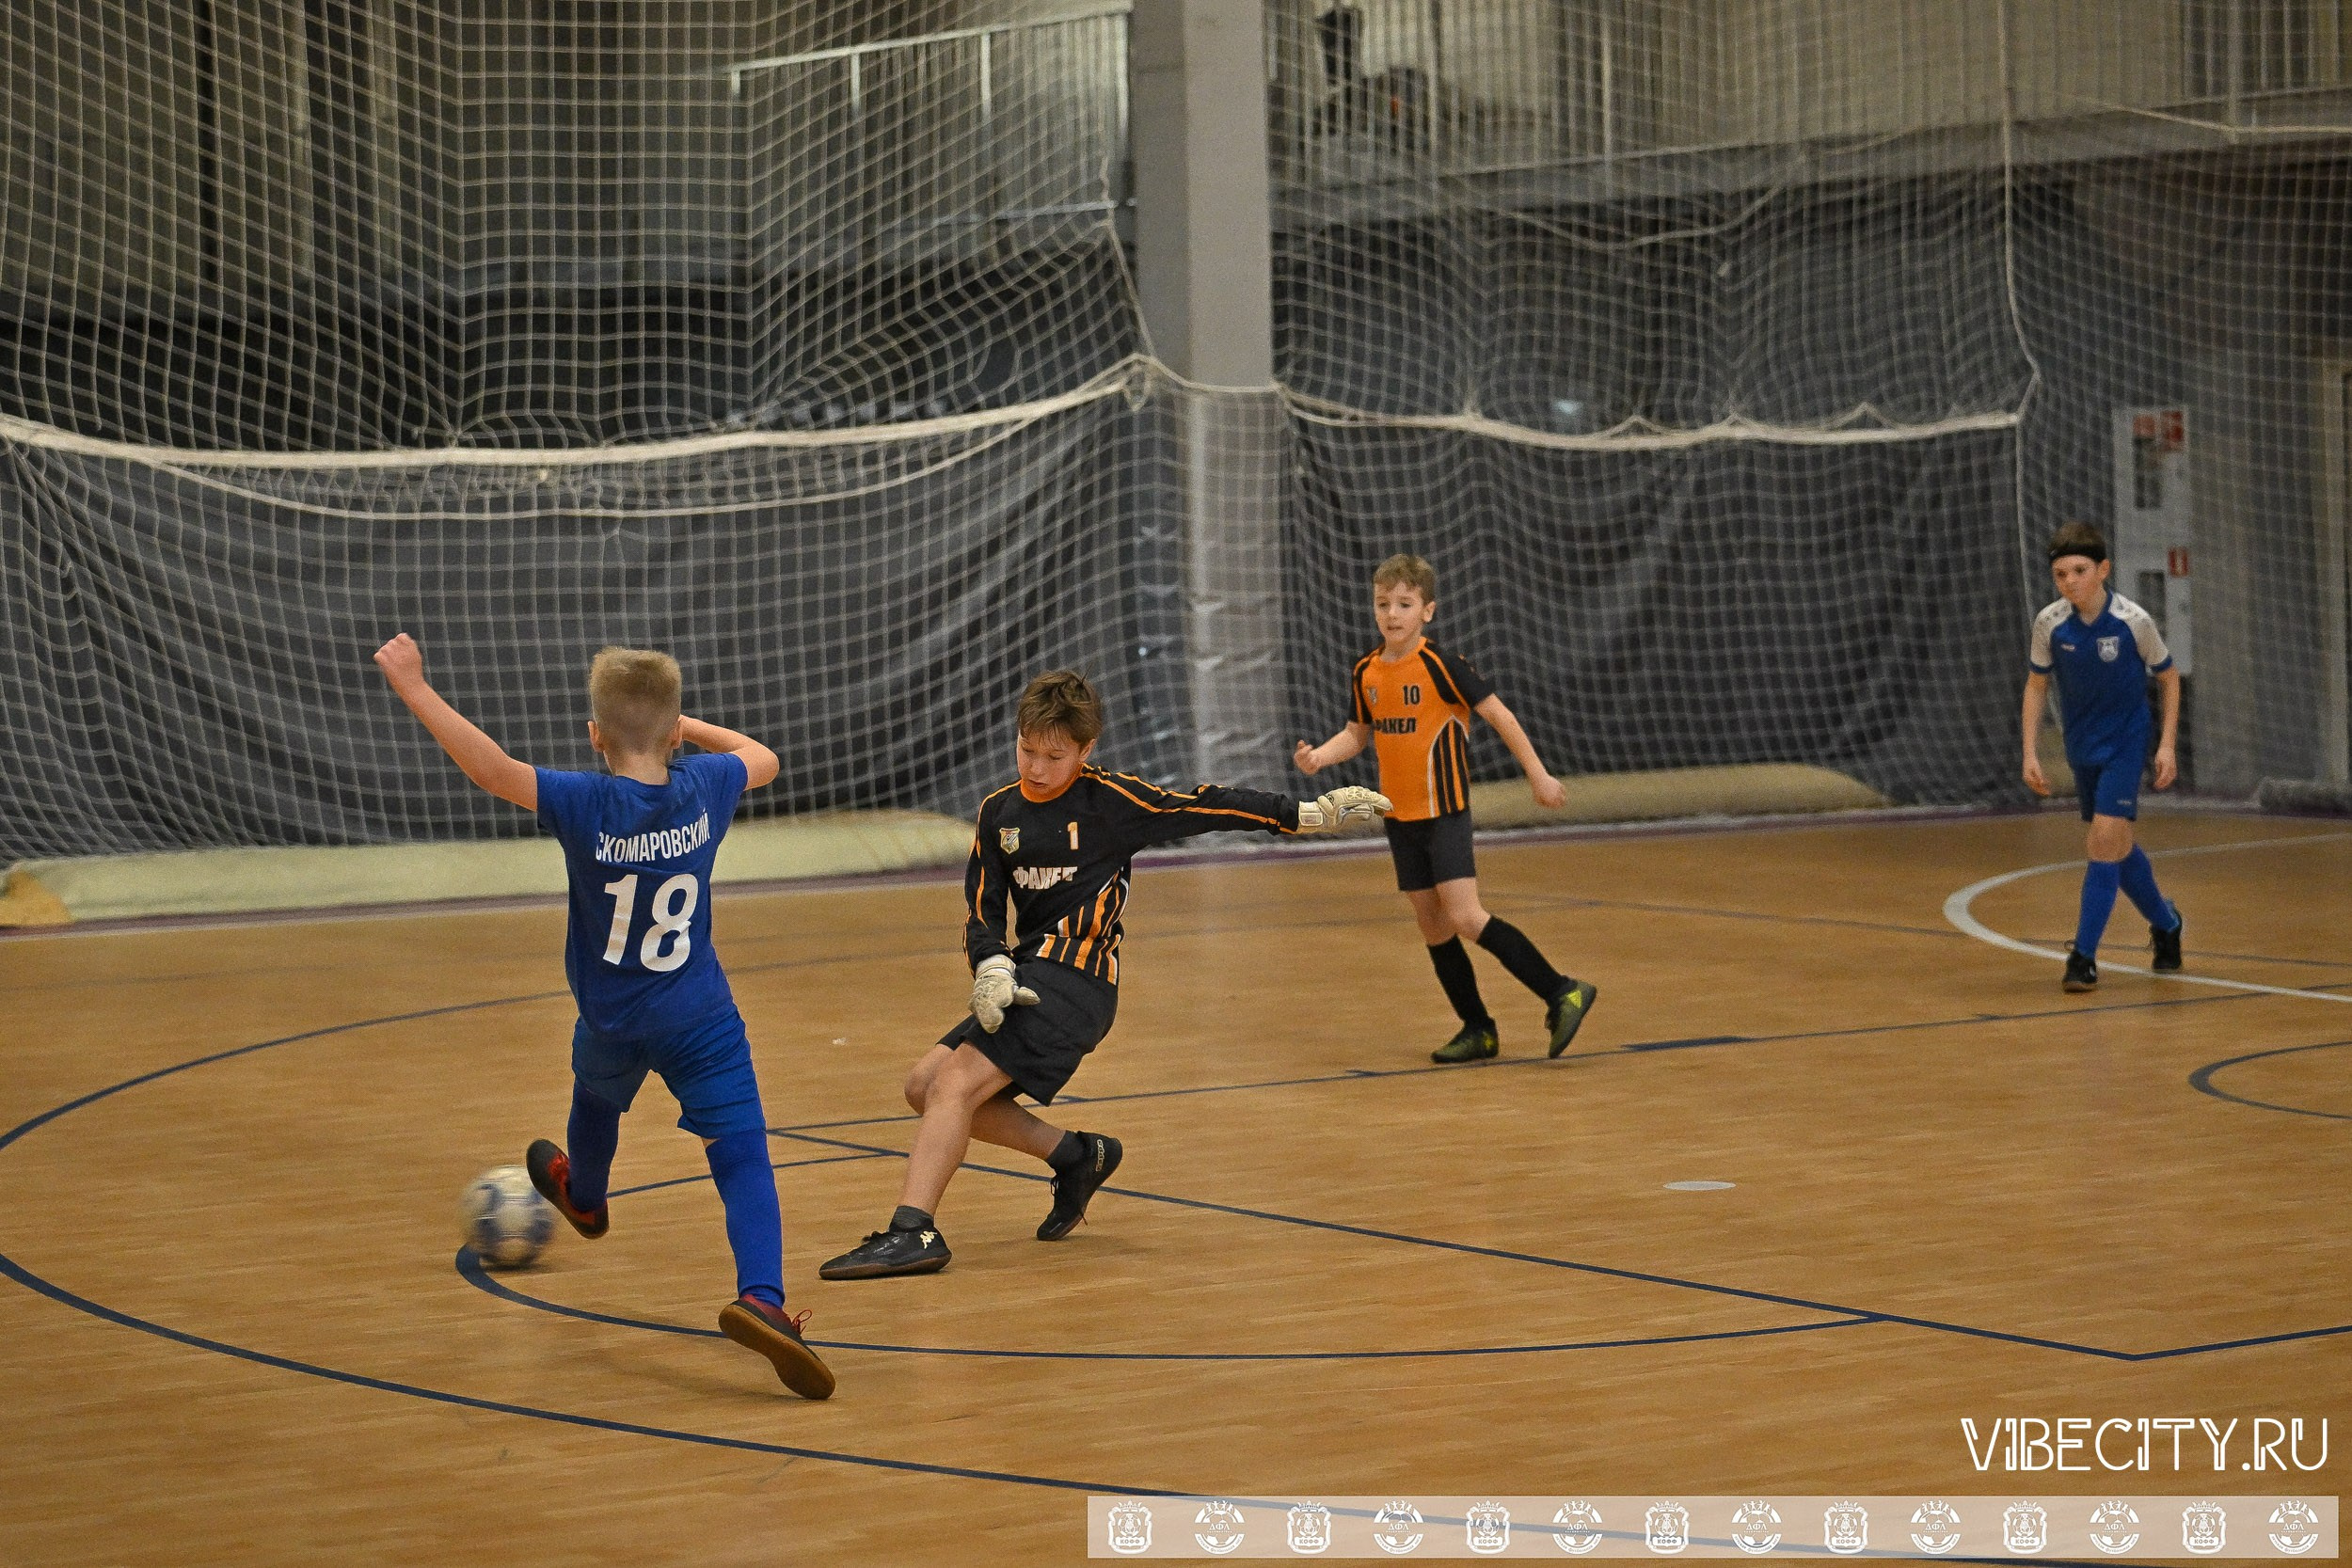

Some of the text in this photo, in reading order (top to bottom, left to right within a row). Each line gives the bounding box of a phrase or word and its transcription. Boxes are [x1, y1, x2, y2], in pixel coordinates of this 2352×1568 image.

[1403, 685, 1421, 705] 10
[596, 808, 710, 863] СКОМАРОВСКИЙ
[1067, 821, 1079, 850] 1
[603, 873, 699, 973] 18
